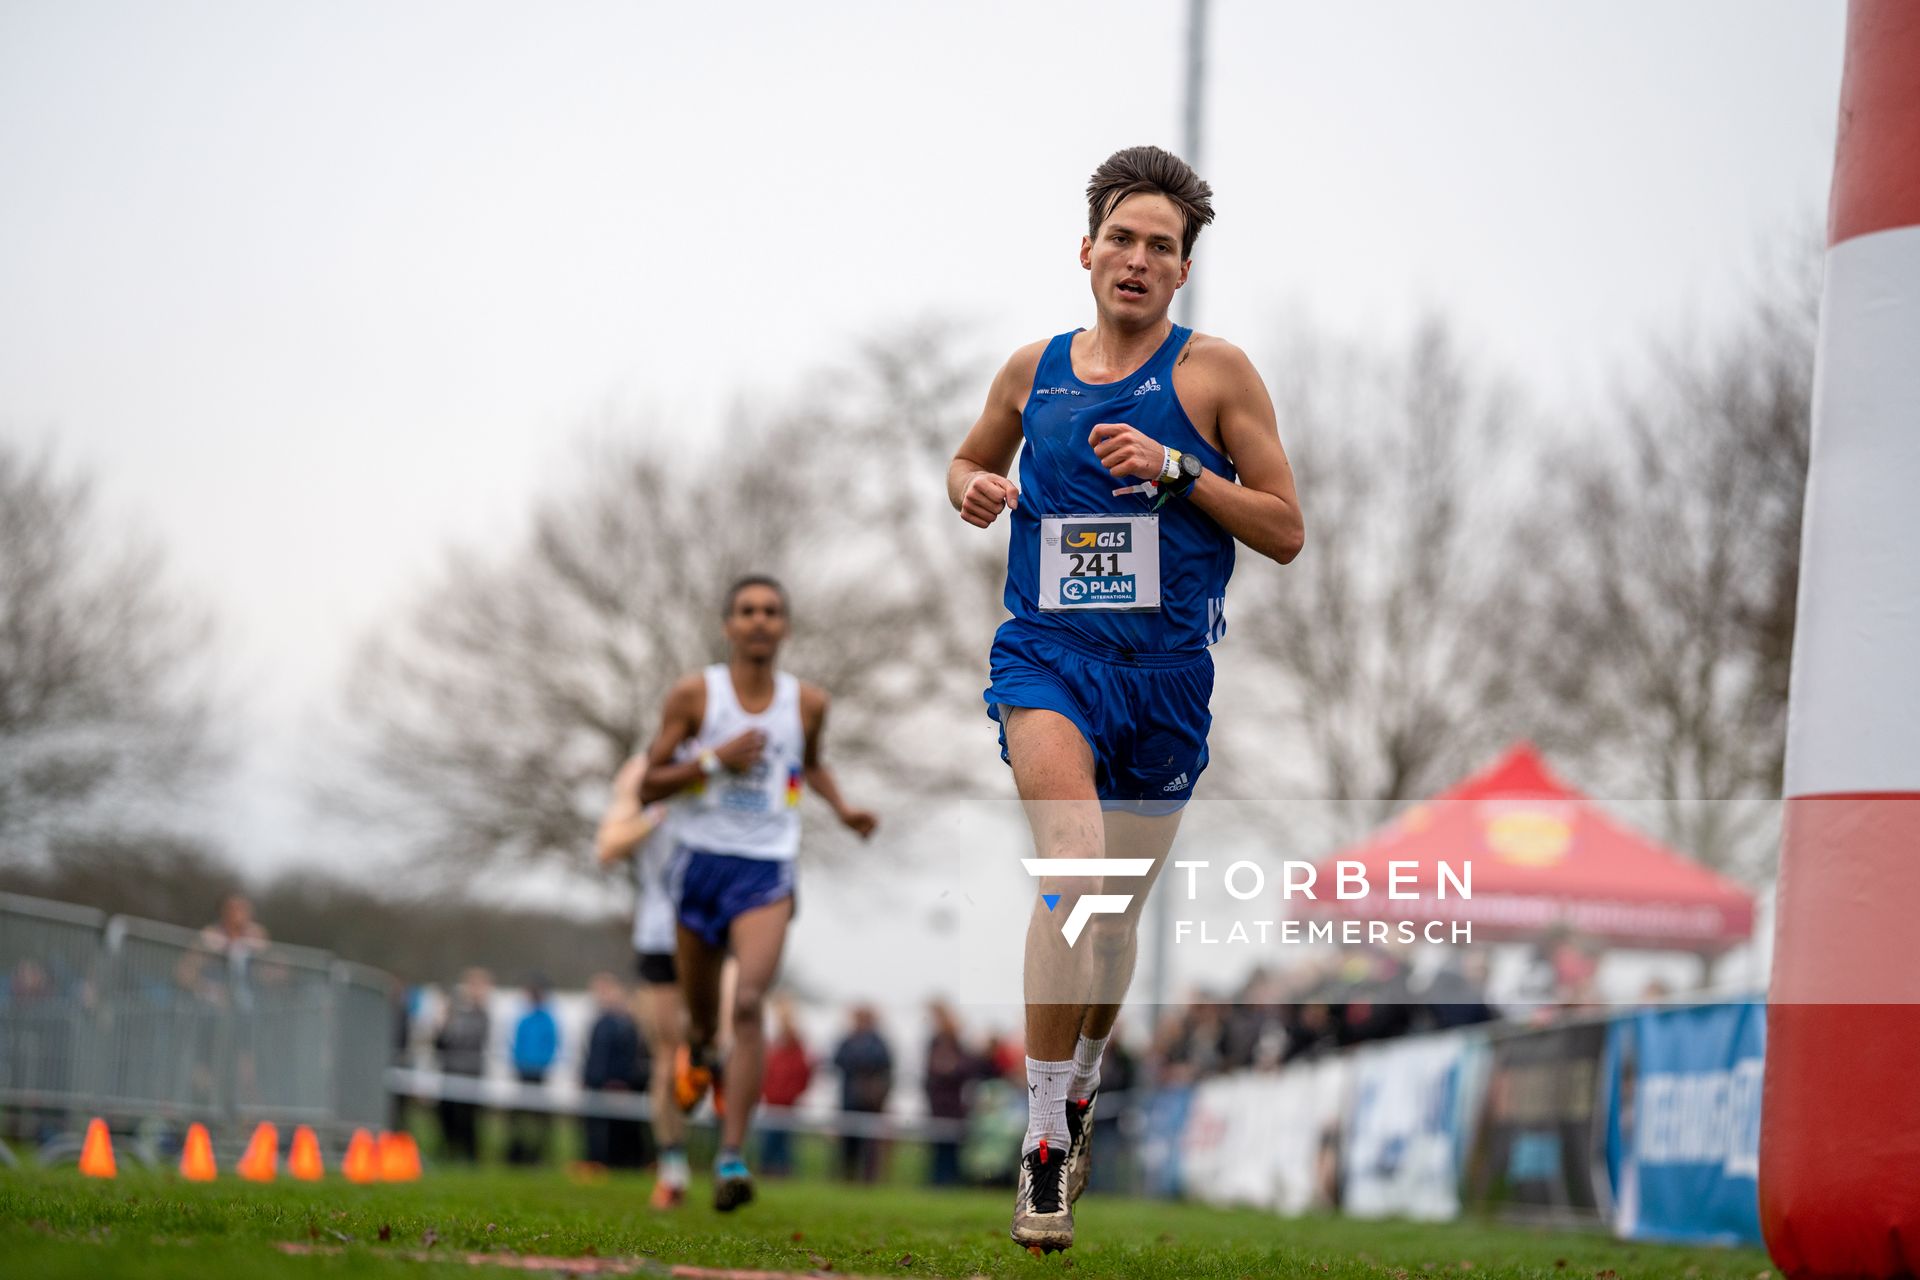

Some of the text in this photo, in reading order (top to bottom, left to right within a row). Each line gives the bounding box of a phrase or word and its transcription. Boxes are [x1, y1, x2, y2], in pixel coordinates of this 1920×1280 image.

[1036, 387, 1081, 396] www.EHRLeu
[1097, 532, 1125, 547] GLS
[1069, 554, 1123, 576] 241
[1090, 581, 1132, 593] PLAN
